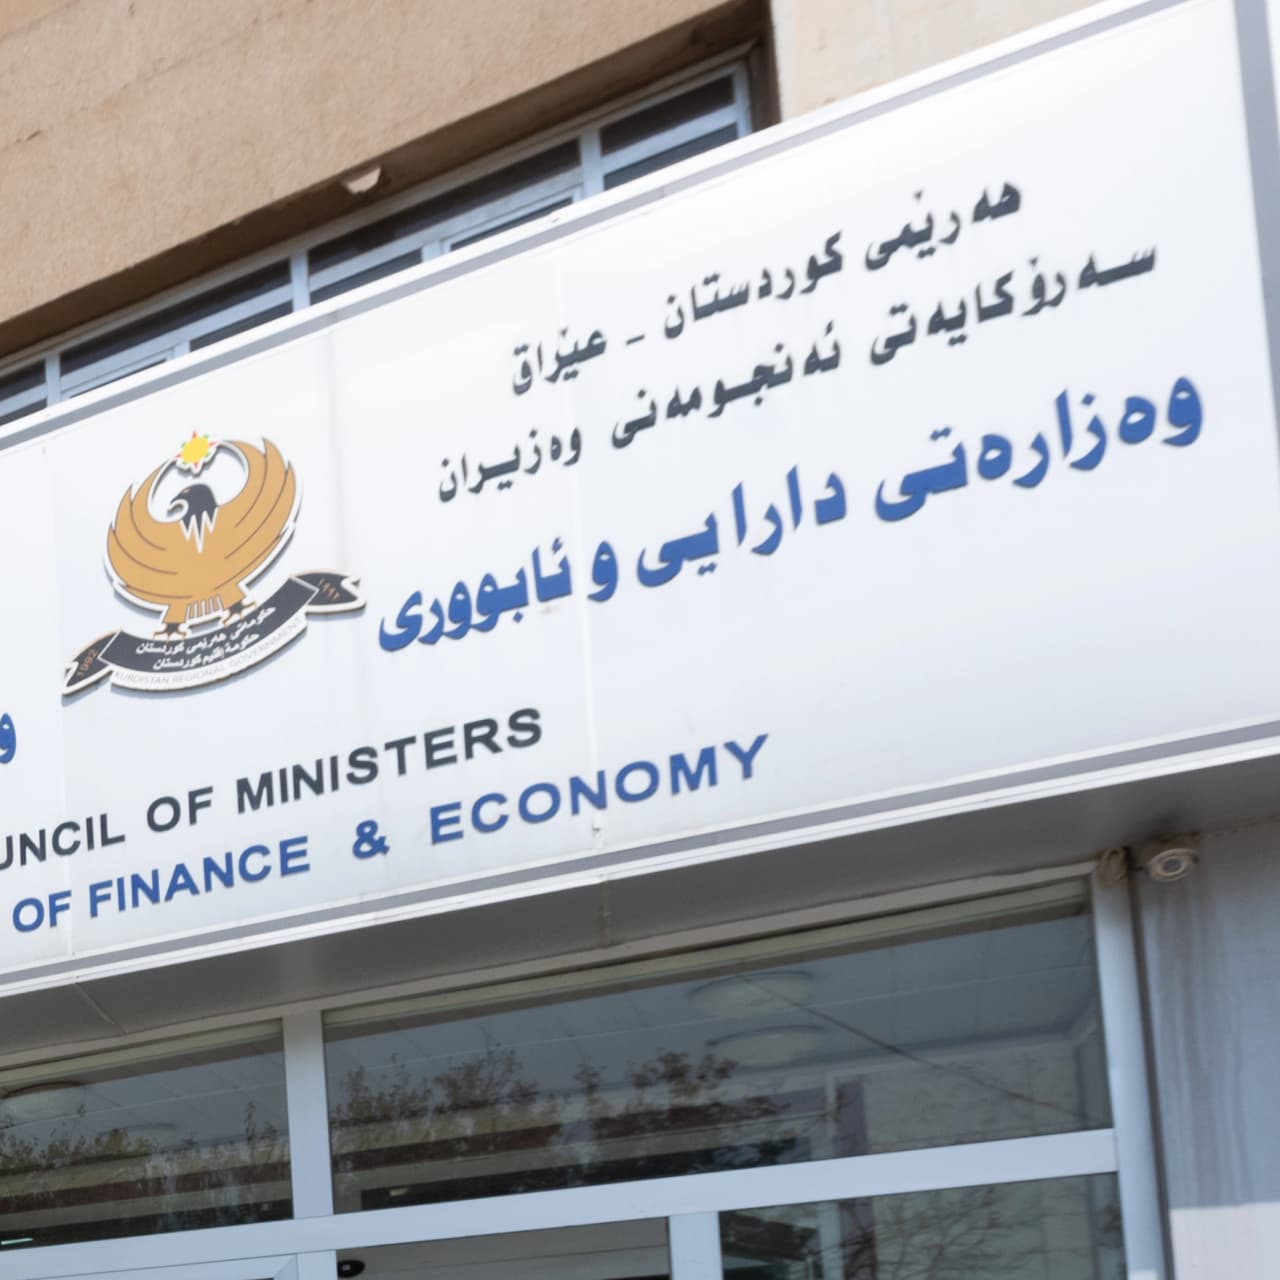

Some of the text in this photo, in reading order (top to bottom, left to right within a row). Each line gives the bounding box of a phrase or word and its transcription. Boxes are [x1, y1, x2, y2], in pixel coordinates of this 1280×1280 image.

[12, 889, 72, 933] OF
[88, 835, 311, 919] FINANCE
[351, 819, 391, 861] &
[429, 733, 769, 846] ECONOMY
[146, 785, 214, 834] OF
[235, 707, 543, 815] MINISTERS
